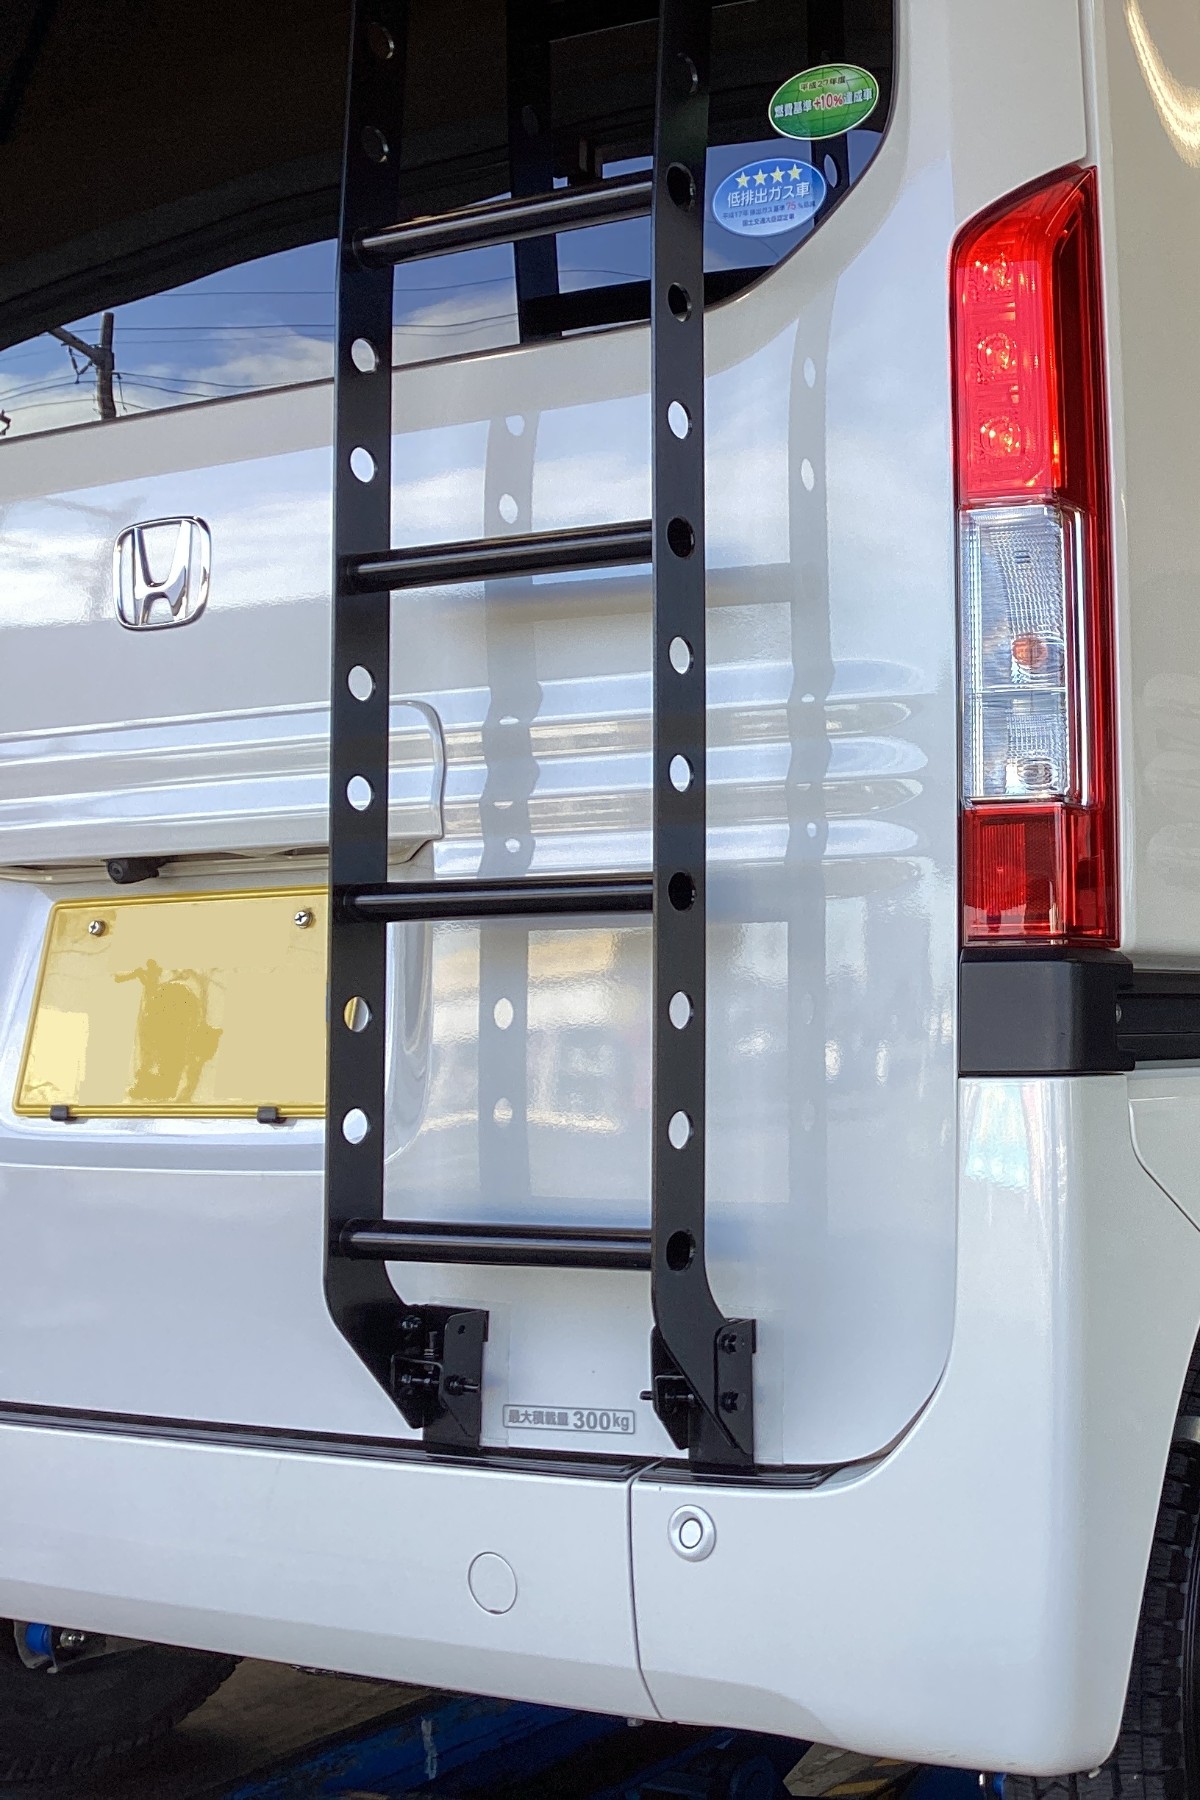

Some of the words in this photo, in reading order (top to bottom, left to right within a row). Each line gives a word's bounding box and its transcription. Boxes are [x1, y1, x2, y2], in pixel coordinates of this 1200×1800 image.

[728, 182, 810, 209] 低排出ガス車
[508, 1409, 569, 1427] 最大積載量
[572, 1411, 630, 1432] 300kg
